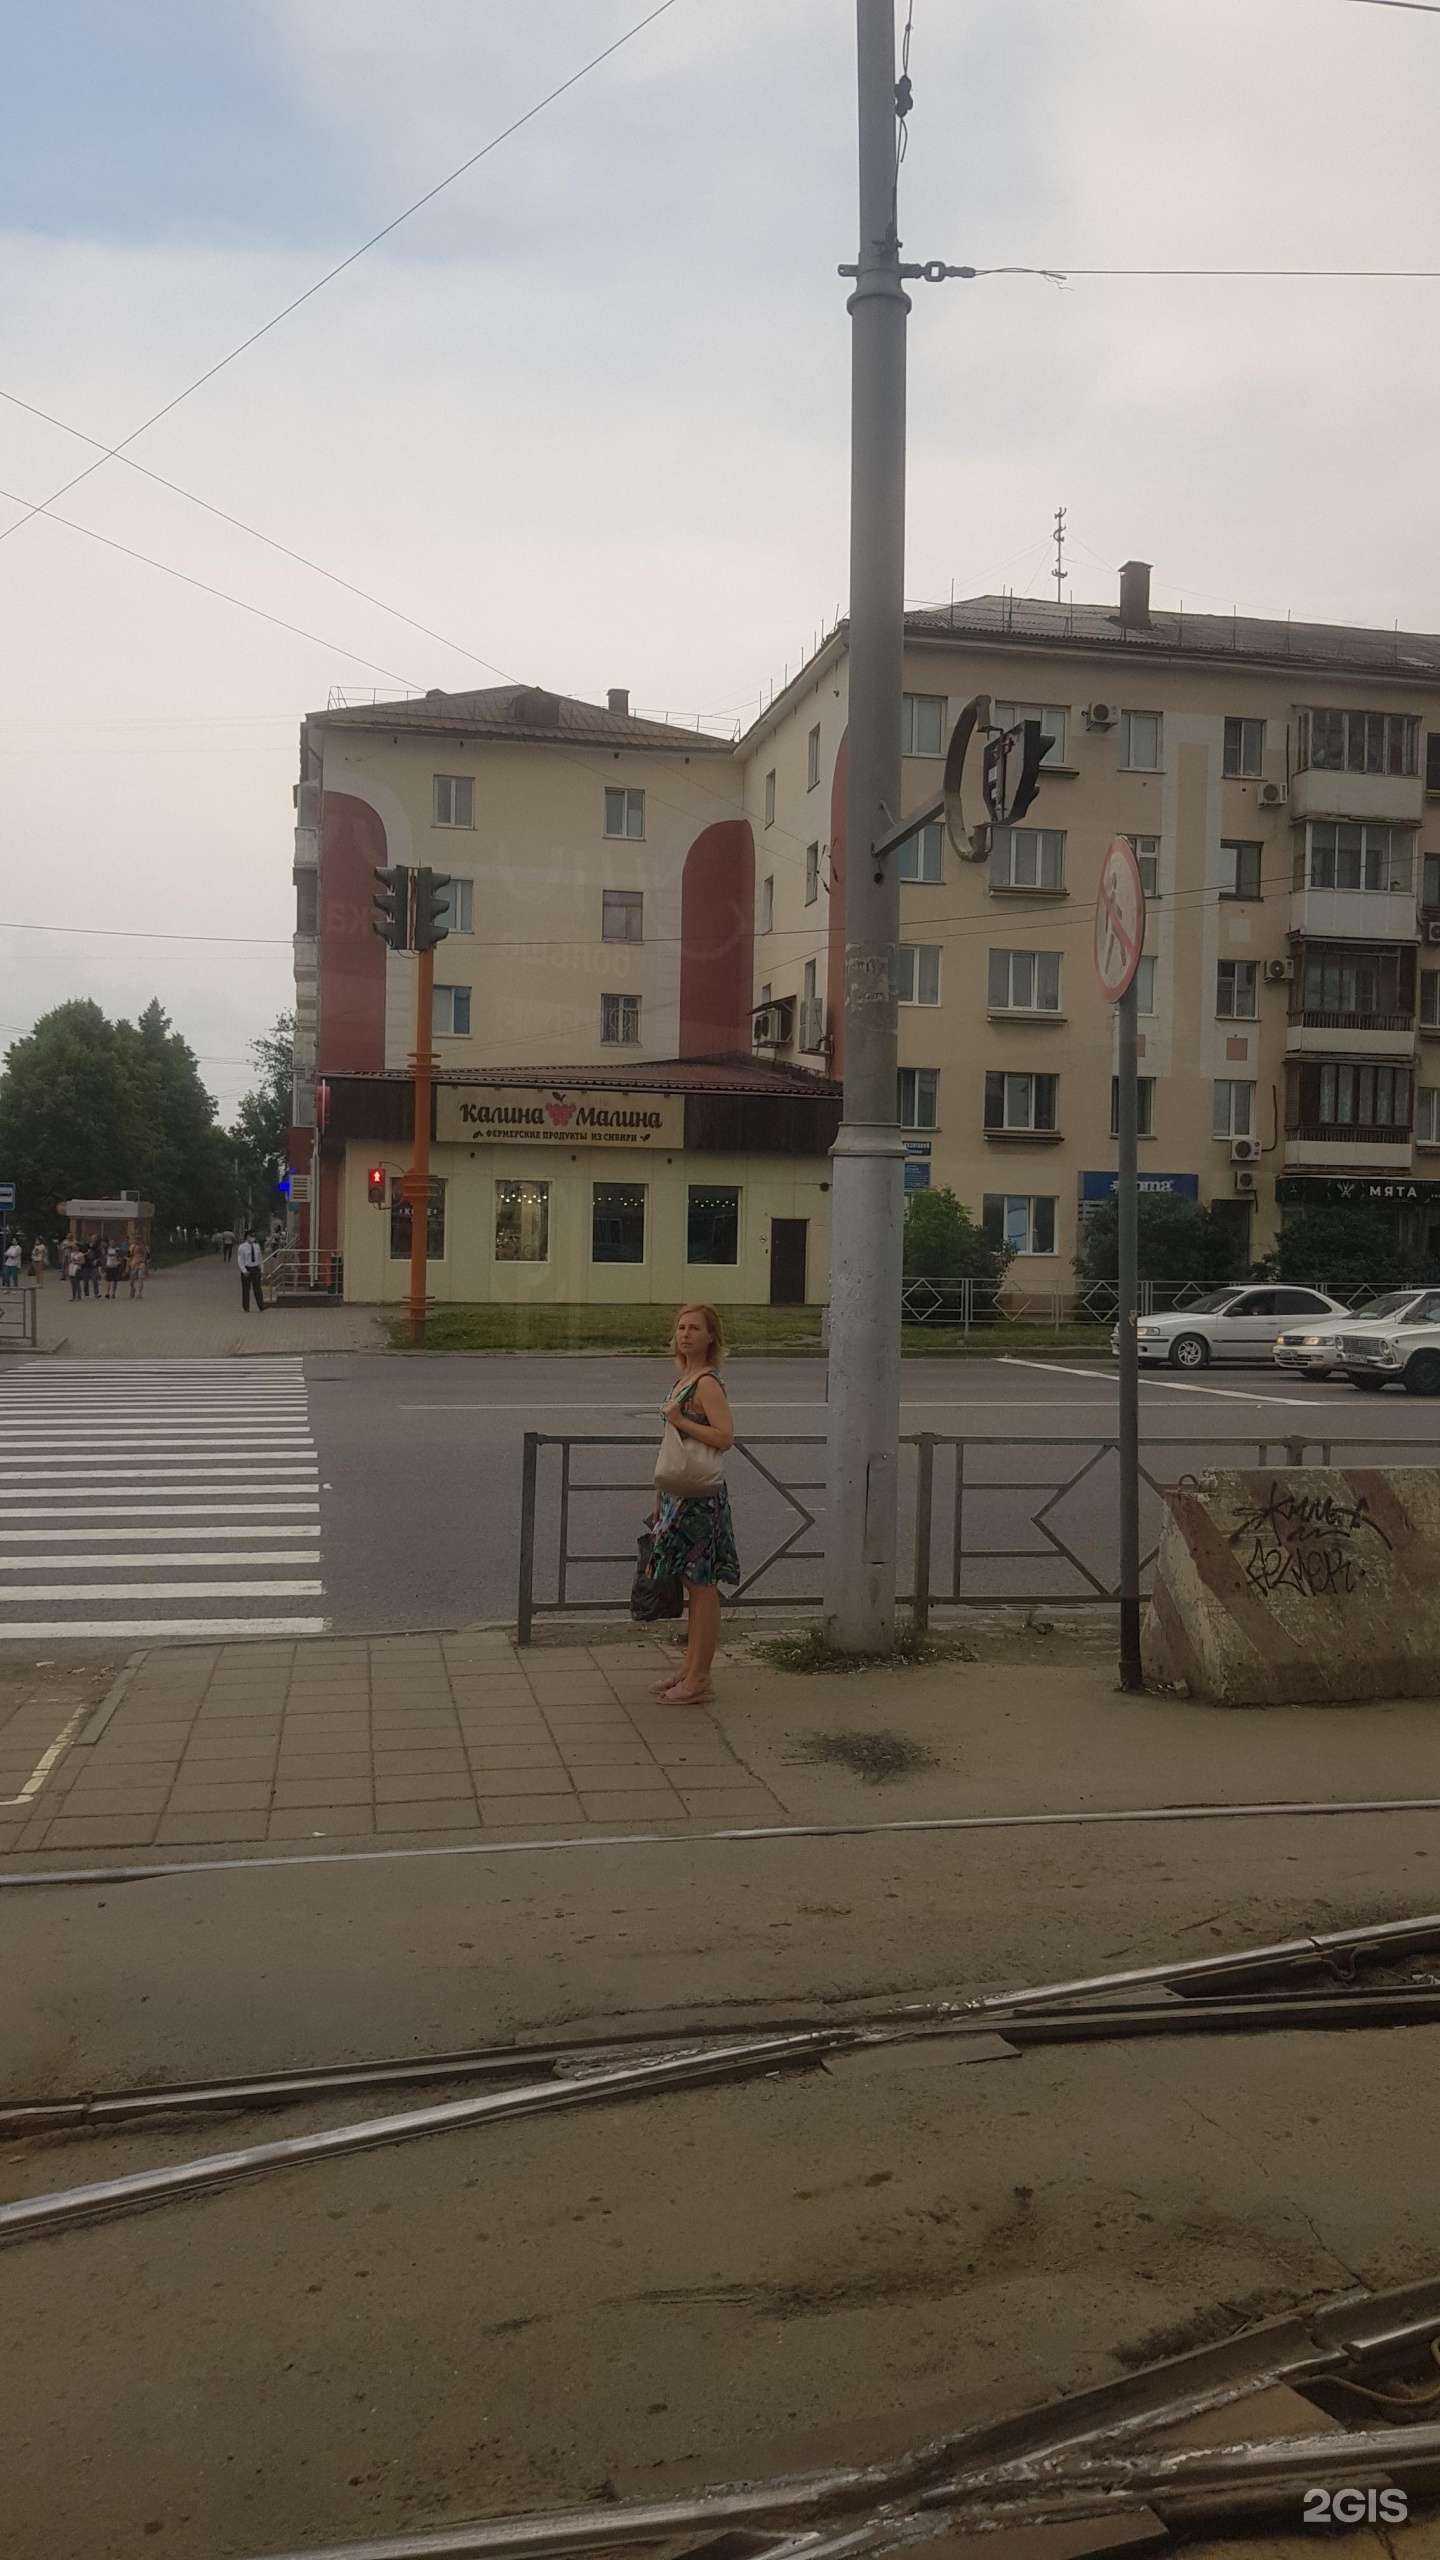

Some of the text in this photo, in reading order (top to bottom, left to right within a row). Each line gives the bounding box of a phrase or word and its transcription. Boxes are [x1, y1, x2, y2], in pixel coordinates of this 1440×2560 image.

[459, 1103, 663, 1129] Калина Малина
[542, 1131, 588, 1141] ПРОДУКТЫ
[592, 1133, 602, 1141] ИЗ
[1369, 1185, 1417, 1198] МЯТА
